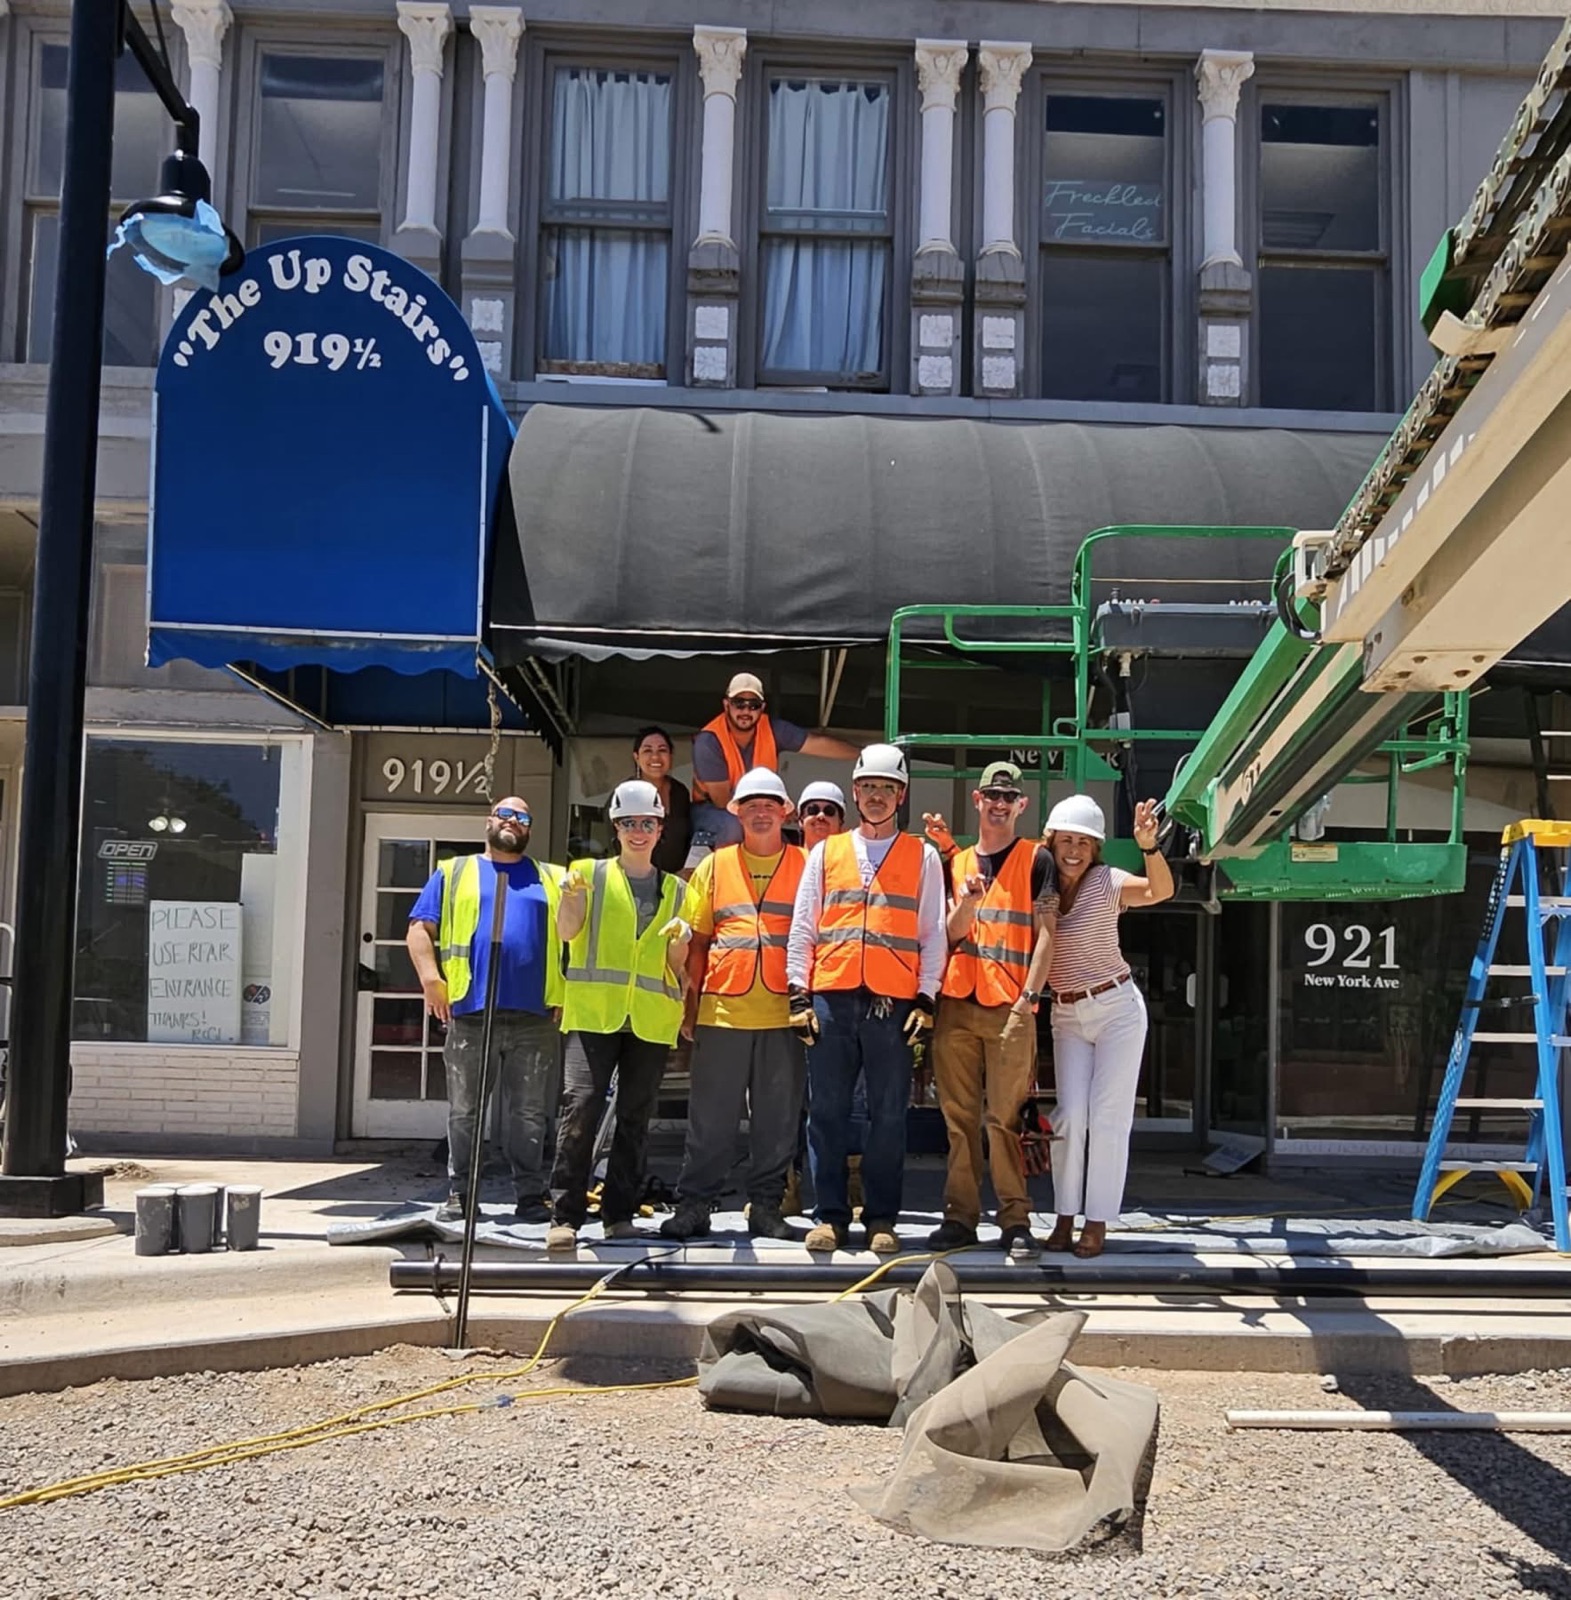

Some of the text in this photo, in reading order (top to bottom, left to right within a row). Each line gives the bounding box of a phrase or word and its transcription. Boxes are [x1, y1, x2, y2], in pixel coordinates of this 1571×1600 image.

[1044, 181, 1160, 207] Freckled
[1050, 212, 1156, 239] Facials
[267, 249, 332, 294] Up
[103, 843, 153, 857] OPEN
[151, 906, 238, 931] PLEASE
[152, 941, 186, 967] USE
[1304, 923, 1401, 969] 921
[149, 977, 232, 999] ENTRANCE
[1304, 973, 1400, 989] New York Ave
